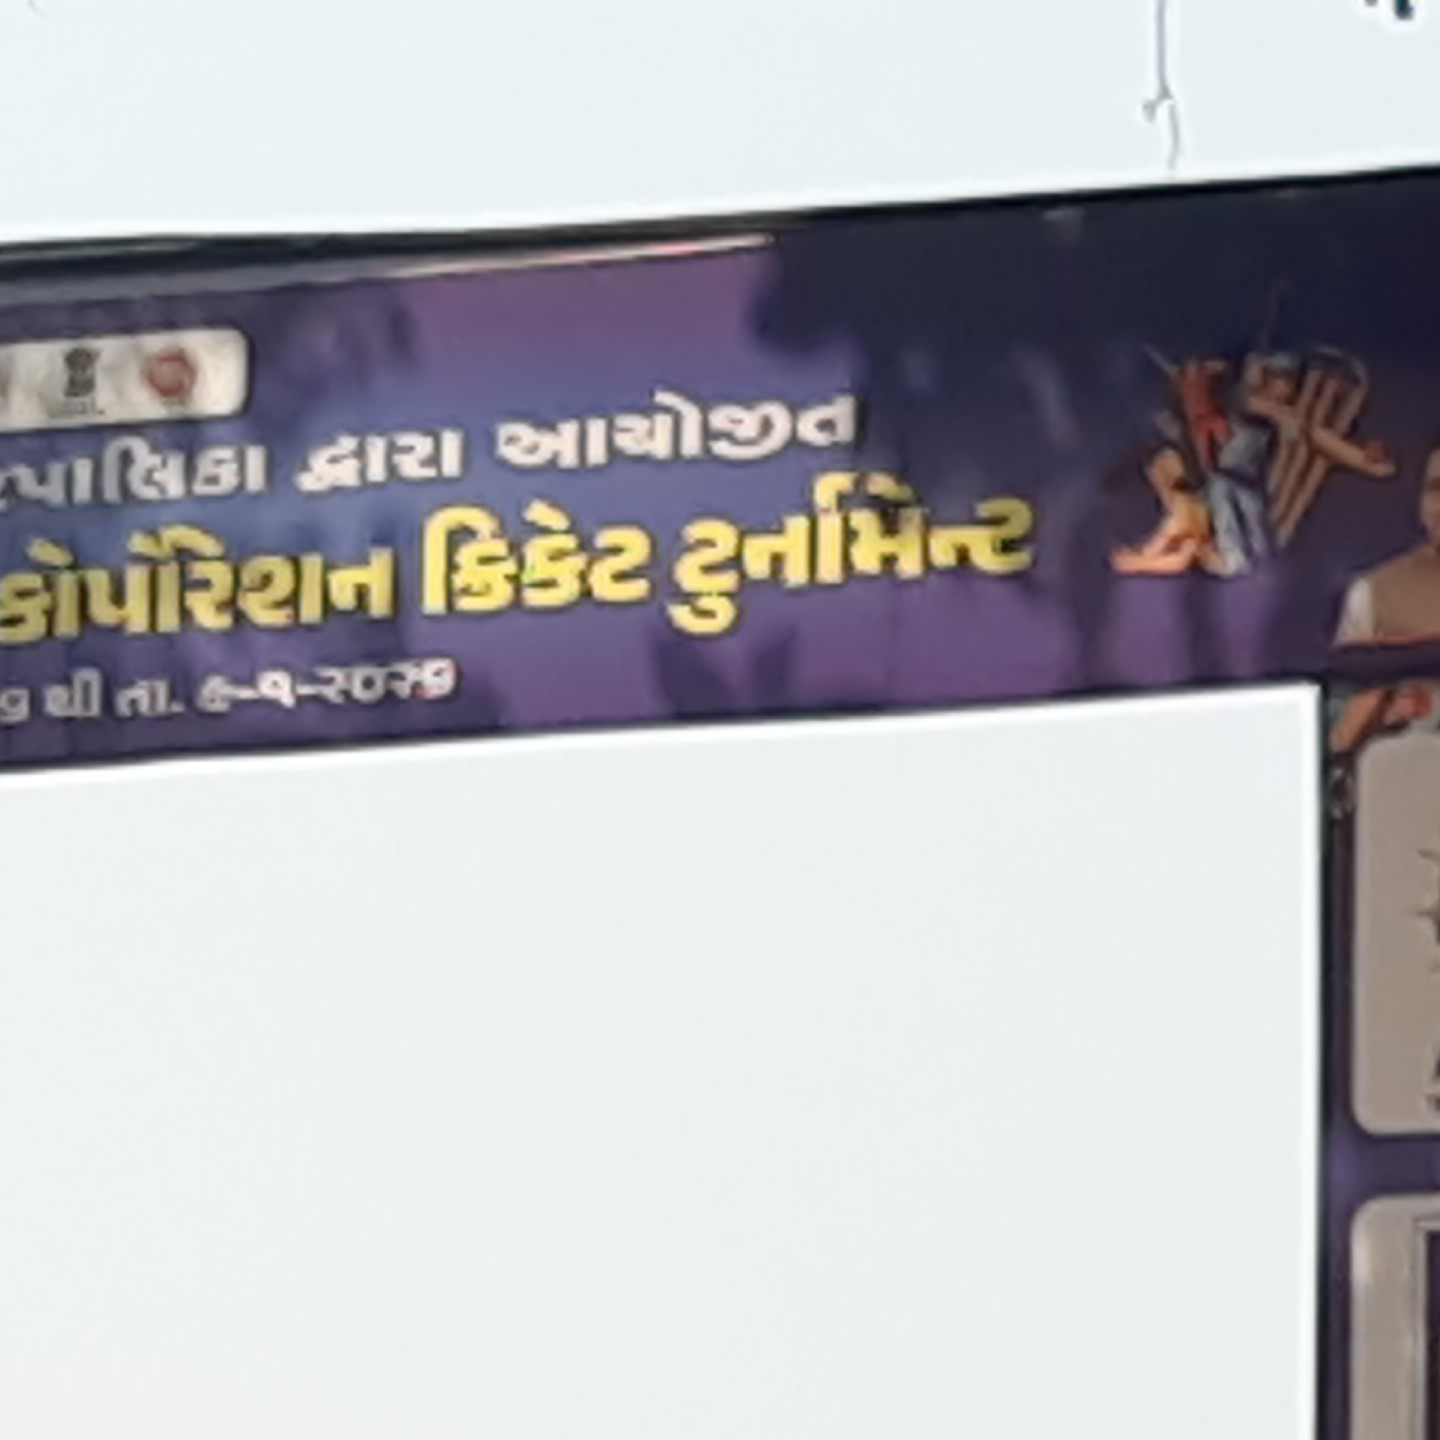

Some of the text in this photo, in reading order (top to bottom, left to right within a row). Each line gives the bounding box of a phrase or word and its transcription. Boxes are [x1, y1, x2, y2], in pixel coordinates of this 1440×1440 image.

[297, 430, 461, 493] દ્વારા
[496, 392, 855, 465] આયોજીત
[422, 500, 650, 615] ક્રિકેટ
